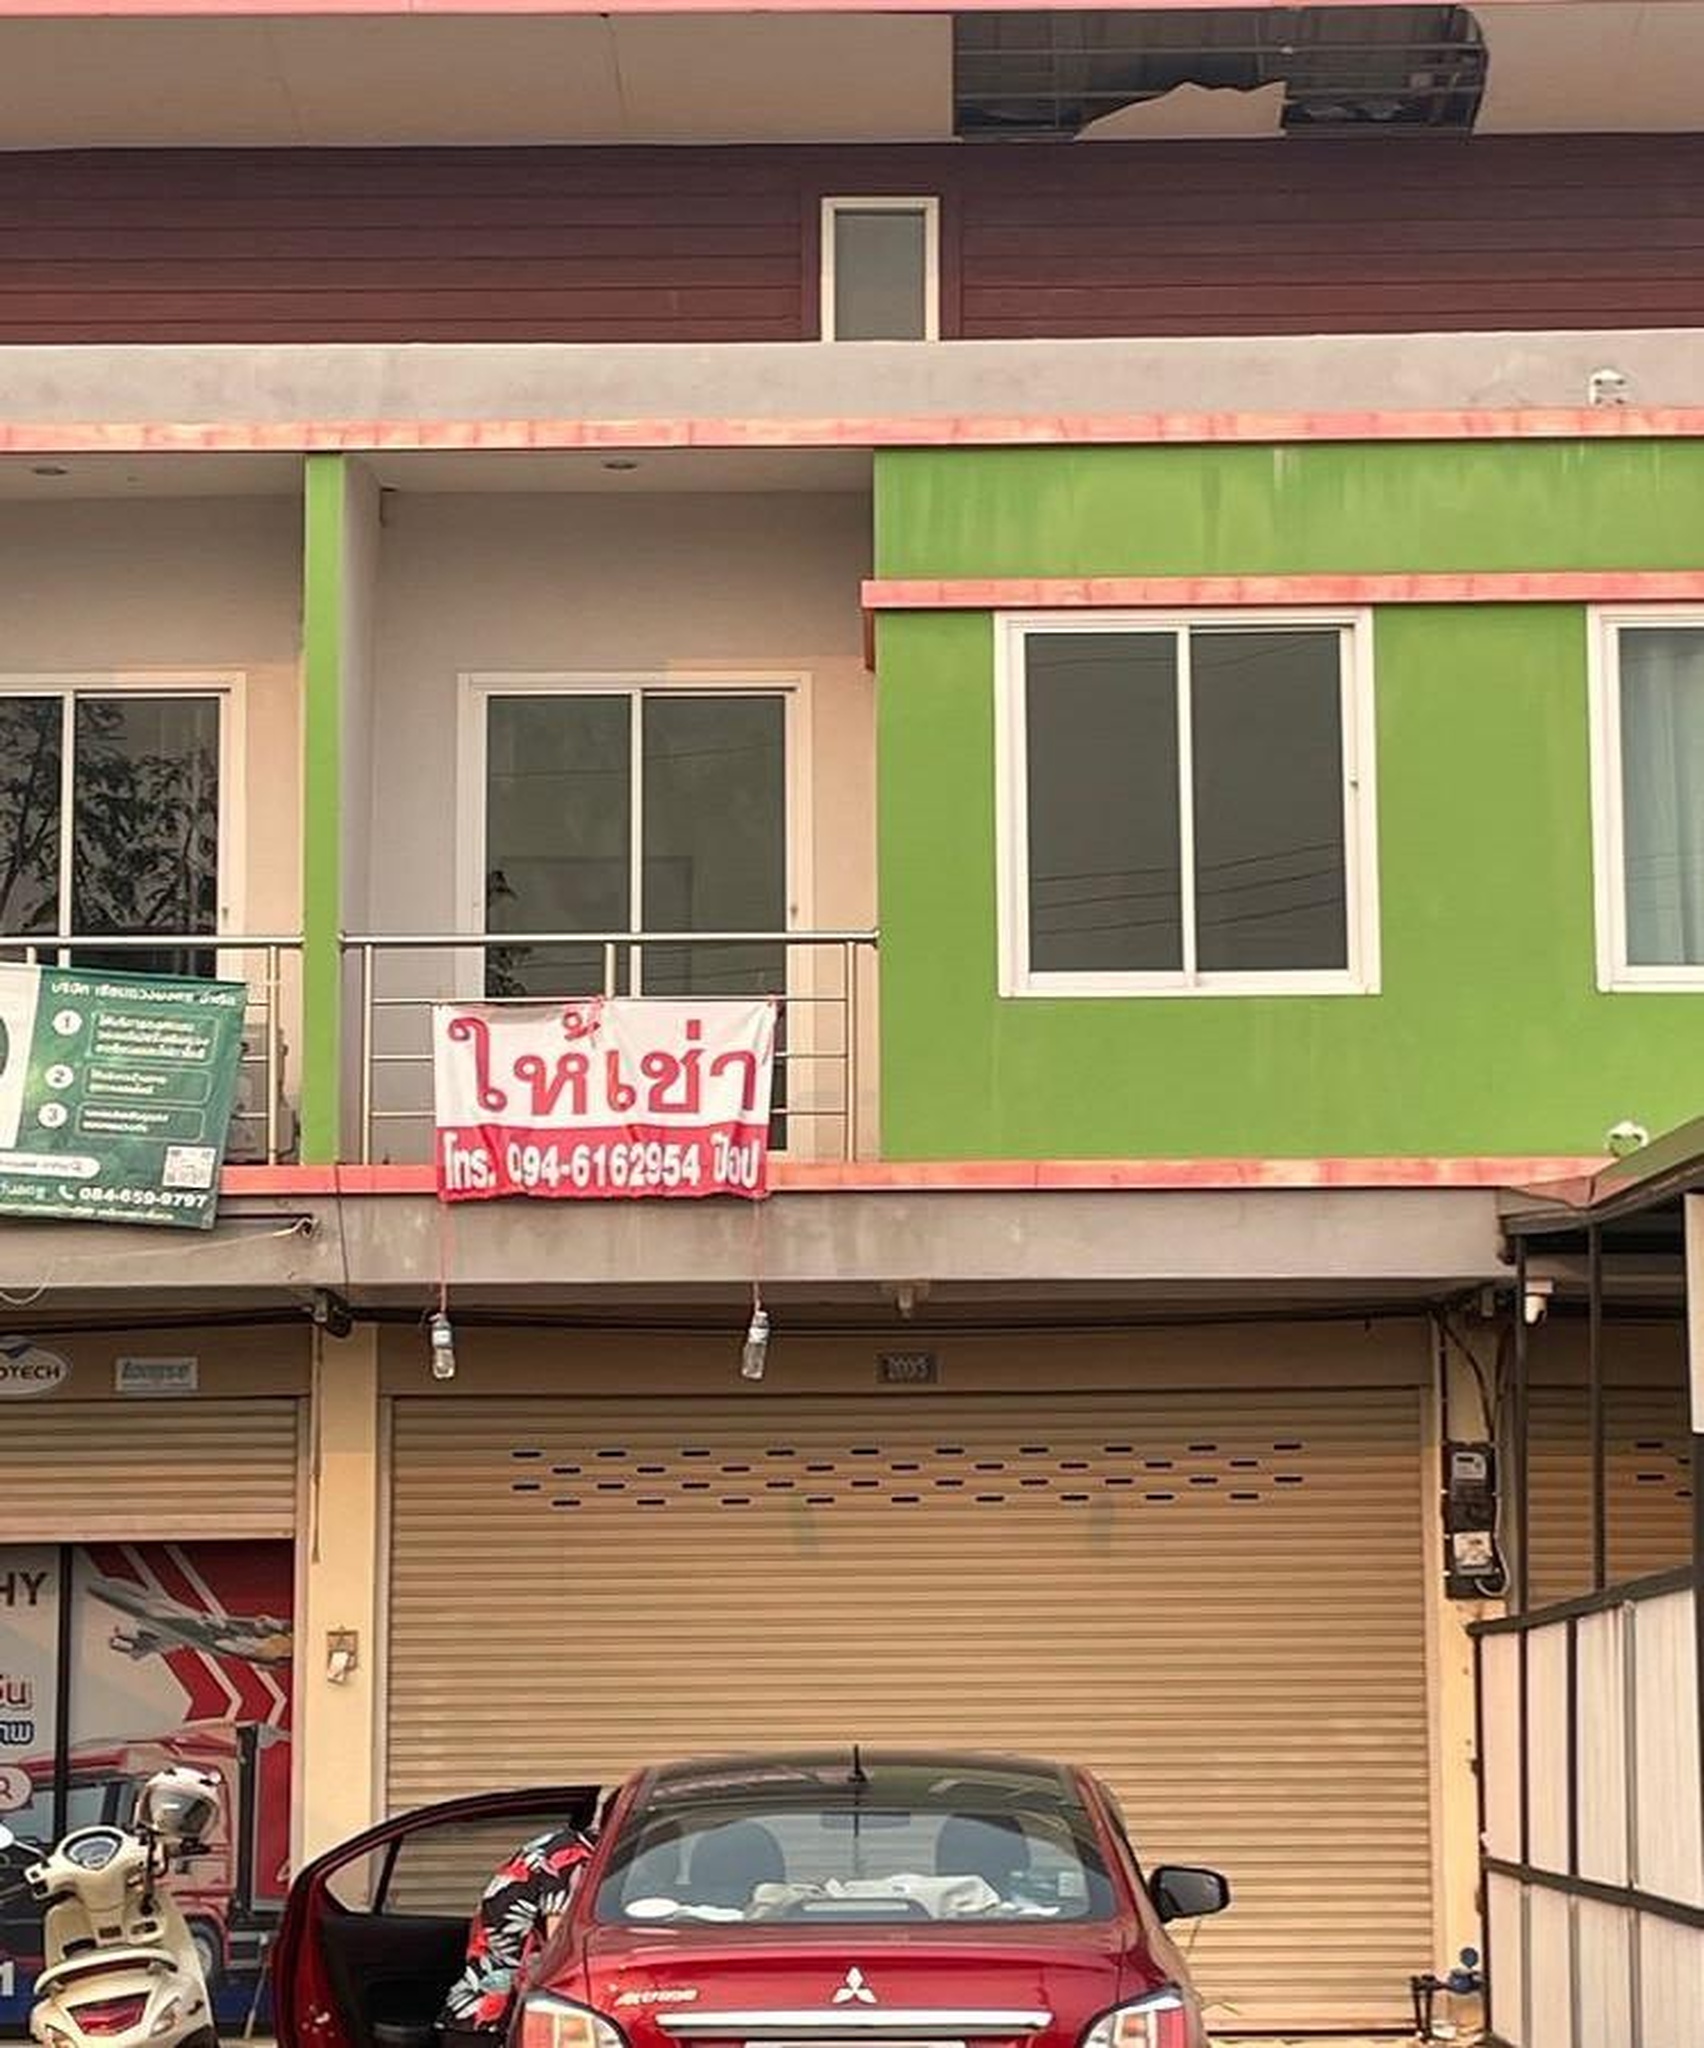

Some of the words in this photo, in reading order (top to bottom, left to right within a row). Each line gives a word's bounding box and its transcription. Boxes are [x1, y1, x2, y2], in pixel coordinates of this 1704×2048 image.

[448, 1010, 757, 1116] ให้เช่า
[442, 1130, 497, 1190] โทร.
[506, 1141, 700, 1188] 094-6162954
